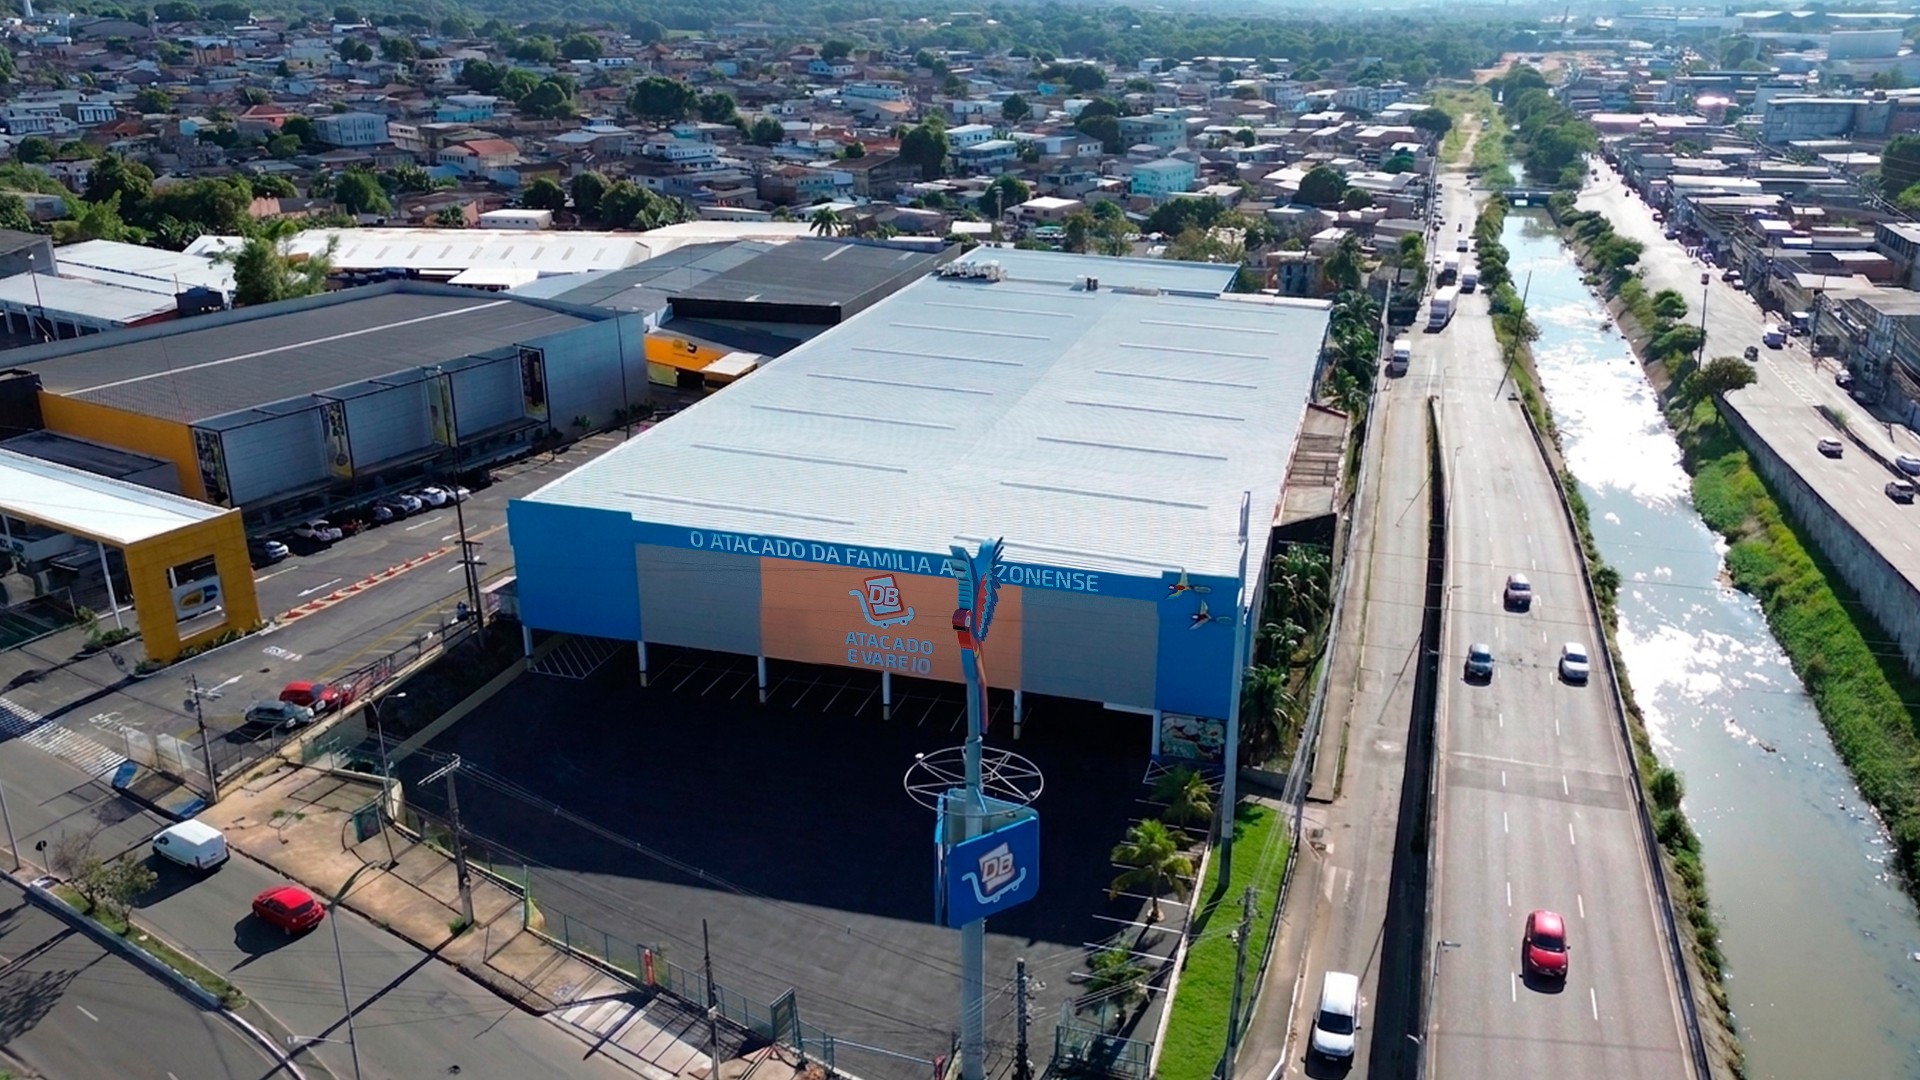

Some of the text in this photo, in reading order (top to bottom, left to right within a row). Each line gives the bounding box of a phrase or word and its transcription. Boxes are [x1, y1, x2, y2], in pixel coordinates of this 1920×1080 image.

[690, 530, 1099, 592] O ATACADO DA FAMILIA AZONENSE
[869, 585, 900, 606] DB
[845, 631, 934, 655] ATACADO
[847, 648, 932, 675] E VAREJO
[982, 852, 1014, 883] DB
